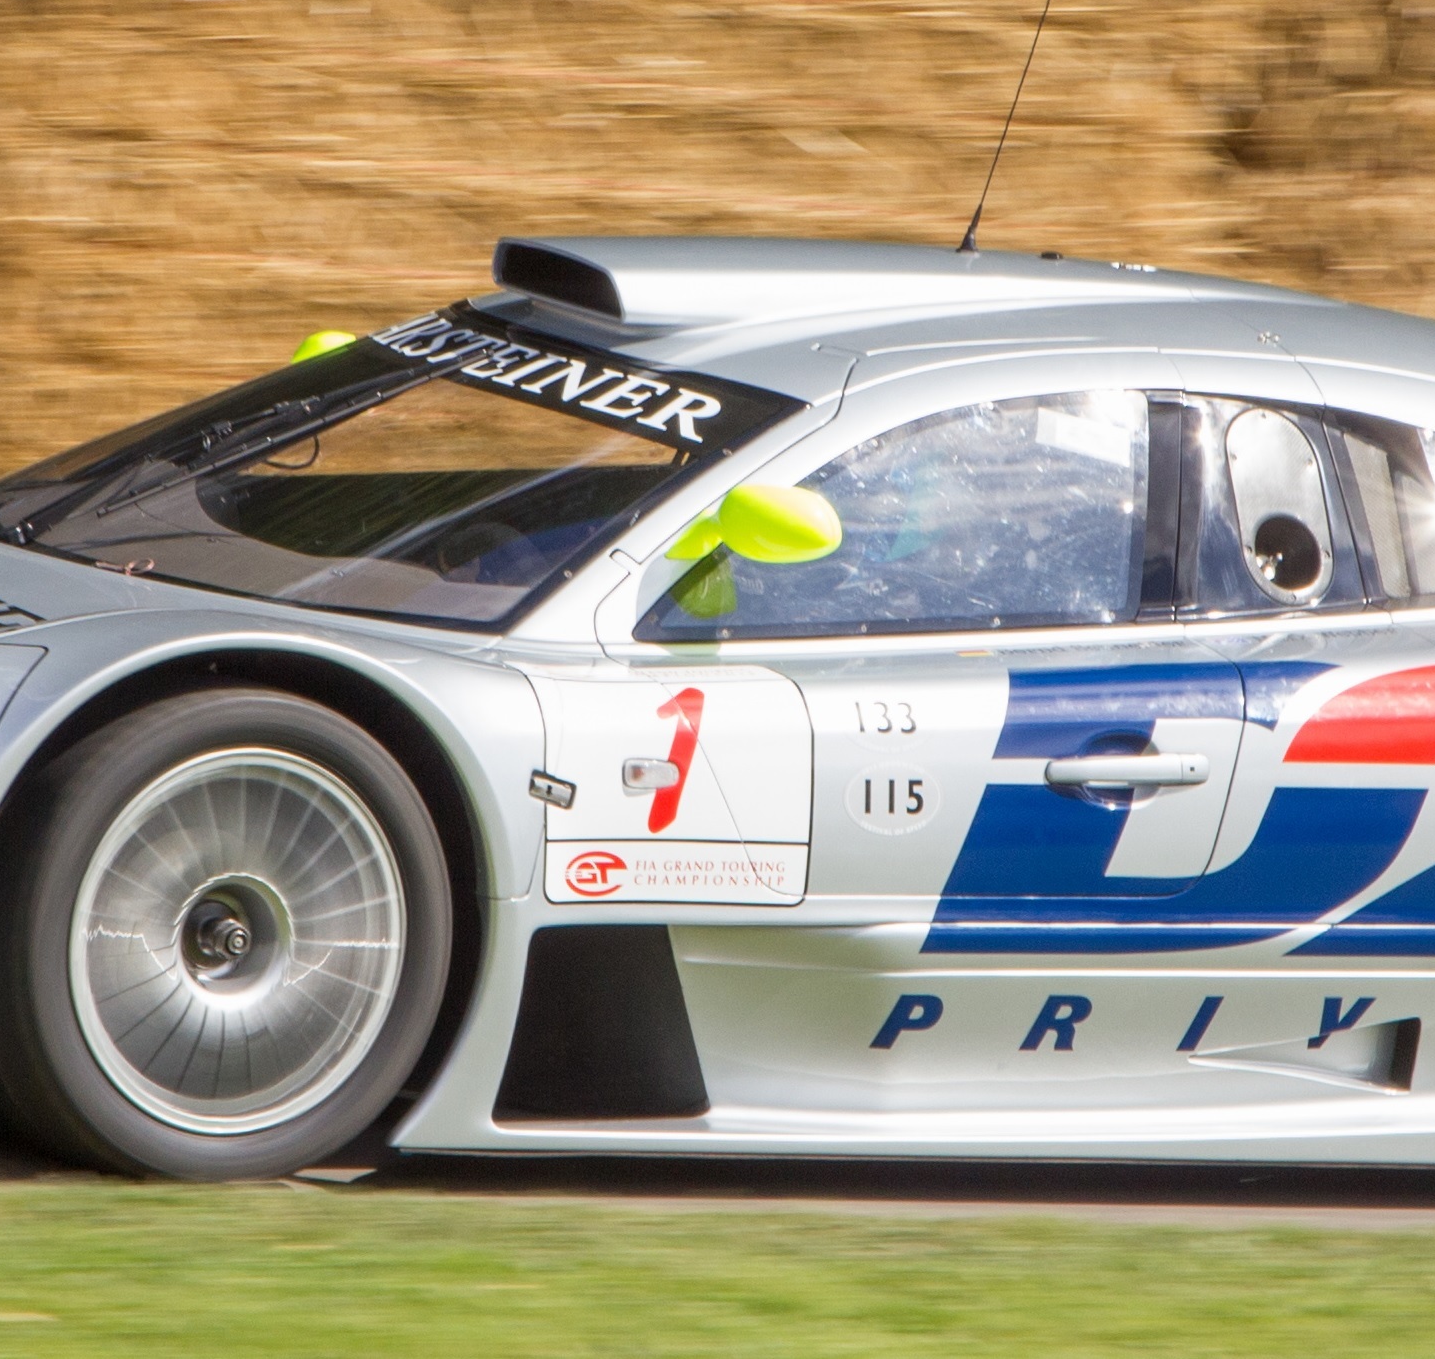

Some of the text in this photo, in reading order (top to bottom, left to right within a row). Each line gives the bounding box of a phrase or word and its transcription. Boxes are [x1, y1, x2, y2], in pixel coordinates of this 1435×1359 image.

[369, 311, 722, 442] ARSTEINER
[854, 700, 917, 734] 133
[648, 687, 705, 834] 1
[864, 778, 924, 815] 115
[633, 874, 786, 887] CHAMPIONSHIP
[635, 860, 786, 873] FIA GRAND TOURING
